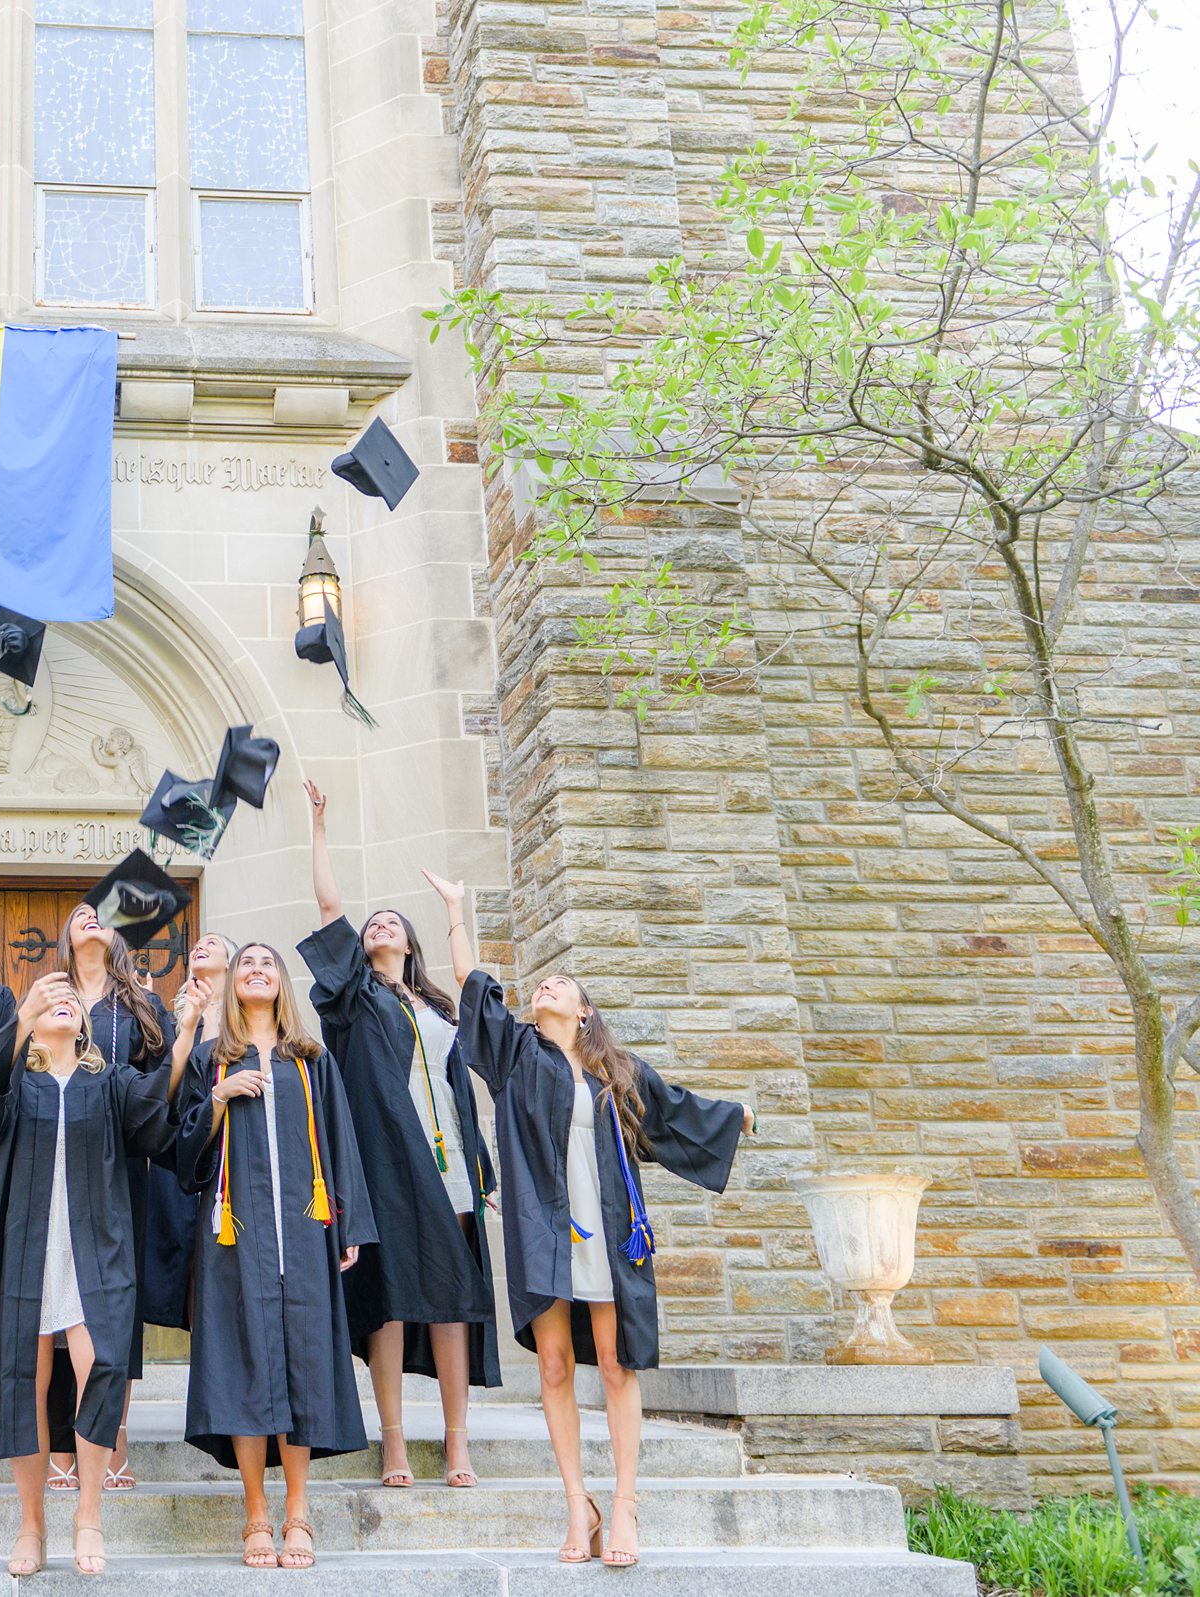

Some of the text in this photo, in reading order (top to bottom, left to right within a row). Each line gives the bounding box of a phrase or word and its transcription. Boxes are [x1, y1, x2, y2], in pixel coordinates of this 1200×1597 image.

[111, 452, 216, 493] trisque
[221, 456, 327, 492] Mariae
[23, 826, 69, 860] per
[73, 821, 194, 861] Maria
